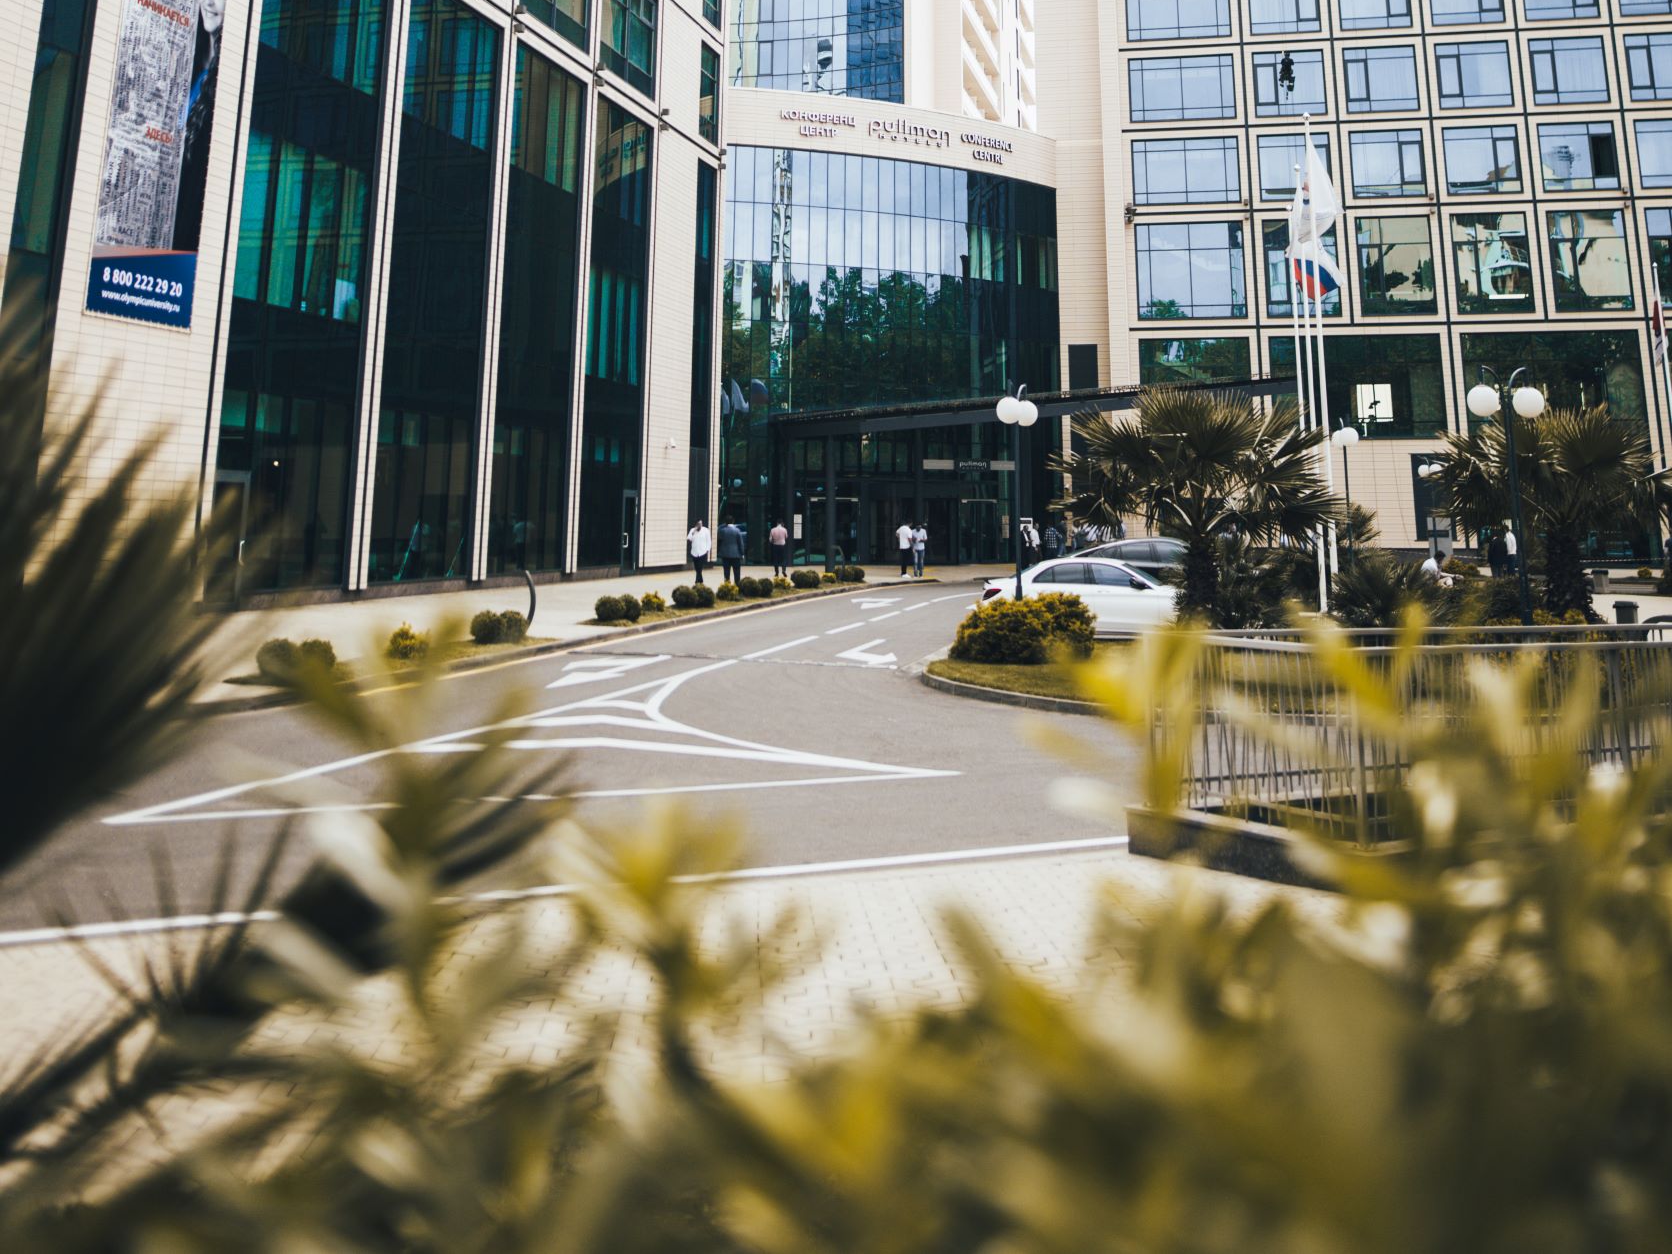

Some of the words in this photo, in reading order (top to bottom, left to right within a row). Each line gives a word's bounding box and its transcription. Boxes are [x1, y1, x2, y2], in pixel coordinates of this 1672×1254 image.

[780, 108, 855, 127] КОНФЕРЕНЦ
[800, 125, 838, 137] ЦЕНТР
[868, 117, 950, 147] pullman
[103, 267, 111, 283] 8
[112, 269, 133, 287] 800
[133, 273, 154, 292] 222
[155, 278, 168, 295] 29
[169, 281, 183, 297] 20
[101, 290, 181, 313] www.olympicuniversity.ru
[959, 460, 987, 468] pullman
